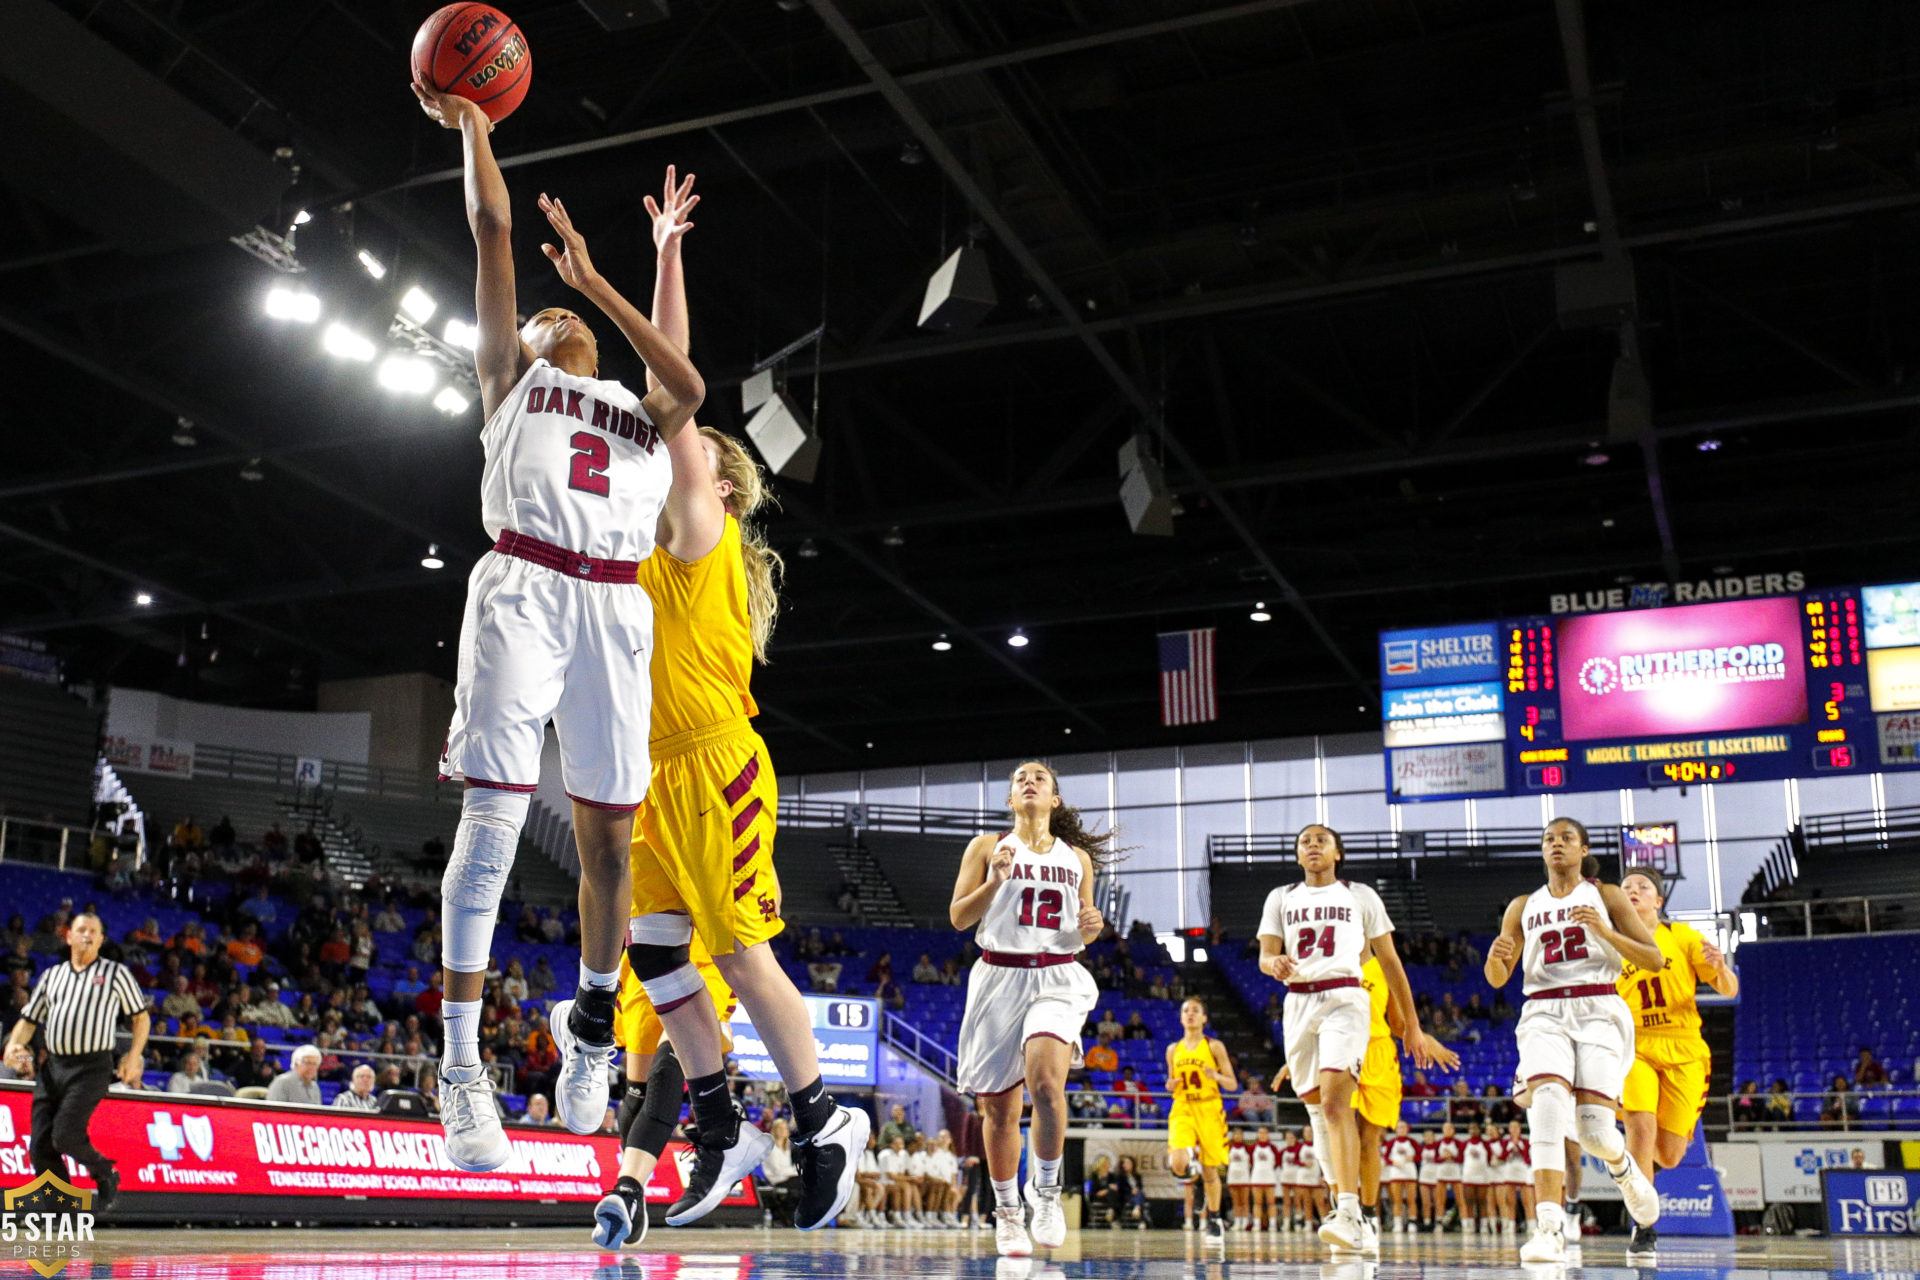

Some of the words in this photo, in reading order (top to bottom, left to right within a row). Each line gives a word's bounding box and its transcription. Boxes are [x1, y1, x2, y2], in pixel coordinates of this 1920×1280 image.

[454, 12, 501, 56] NCAA
[466, 32, 527, 89] Wilson
[526, 386, 586, 422] OAK
[591, 397, 660, 456] RIDGE
[568, 430, 611, 498] 2
[1550, 588, 1625, 614] BLUE
[1675, 571, 1806, 602] RAIDERS
[1421, 634, 1493, 656] SHELTER
[1619, 643, 1785, 676] RUTHERFORD
[1826, 682, 1845, 702] 3
[1388, 702, 1425, 718] Join
[1424, 698, 1454, 715] the
[1454, 693, 1499, 712] Club!
[1526, 705, 1539, 725] 3
[1825, 701, 1840, 720] 5
[1520, 725, 1534, 742] 4
[1586, 747, 1632, 764] MIDDLE
[1634, 741, 1706, 760] TENNESSEE
[1708, 735, 1788, 756] BASKETBALL
[1830, 748, 1851, 767] 15
[1663, 761, 1706, 782] 4:04
[1007, 863, 1035, 880] AK
[1040, 866, 1079, 890] RIDGE
[1018, 887, 1063, 931] 12
[1286, 907, 1310, 926] OAK
[1314, 906, 1352, 923] RIDGE
[1527, 910, 1552, 931] OAK
[1297, 926, 1335, 960] 24
[1540, 926, 1589, 965] 22
[1637, 976, 1667, 1010] 11
[837, 1003, 863, 1027] 15
[1642, 1012, 1672, 1028] HILL
[1181, 1070, 1202, 1090] 14
[252, 1122, 371, 1168] BLUECROSS
[138, 1163, 156, 1183] of
[157, 1163, 238, 1185] Tennessee
[267, 1170, 327, 1188] TENNESSEE
[327, 1173, 382, 1189] SECONDARY
[383, 1175, 420, 1190] SCHOOL
[1872, 1181, 1902, 1201] FB
